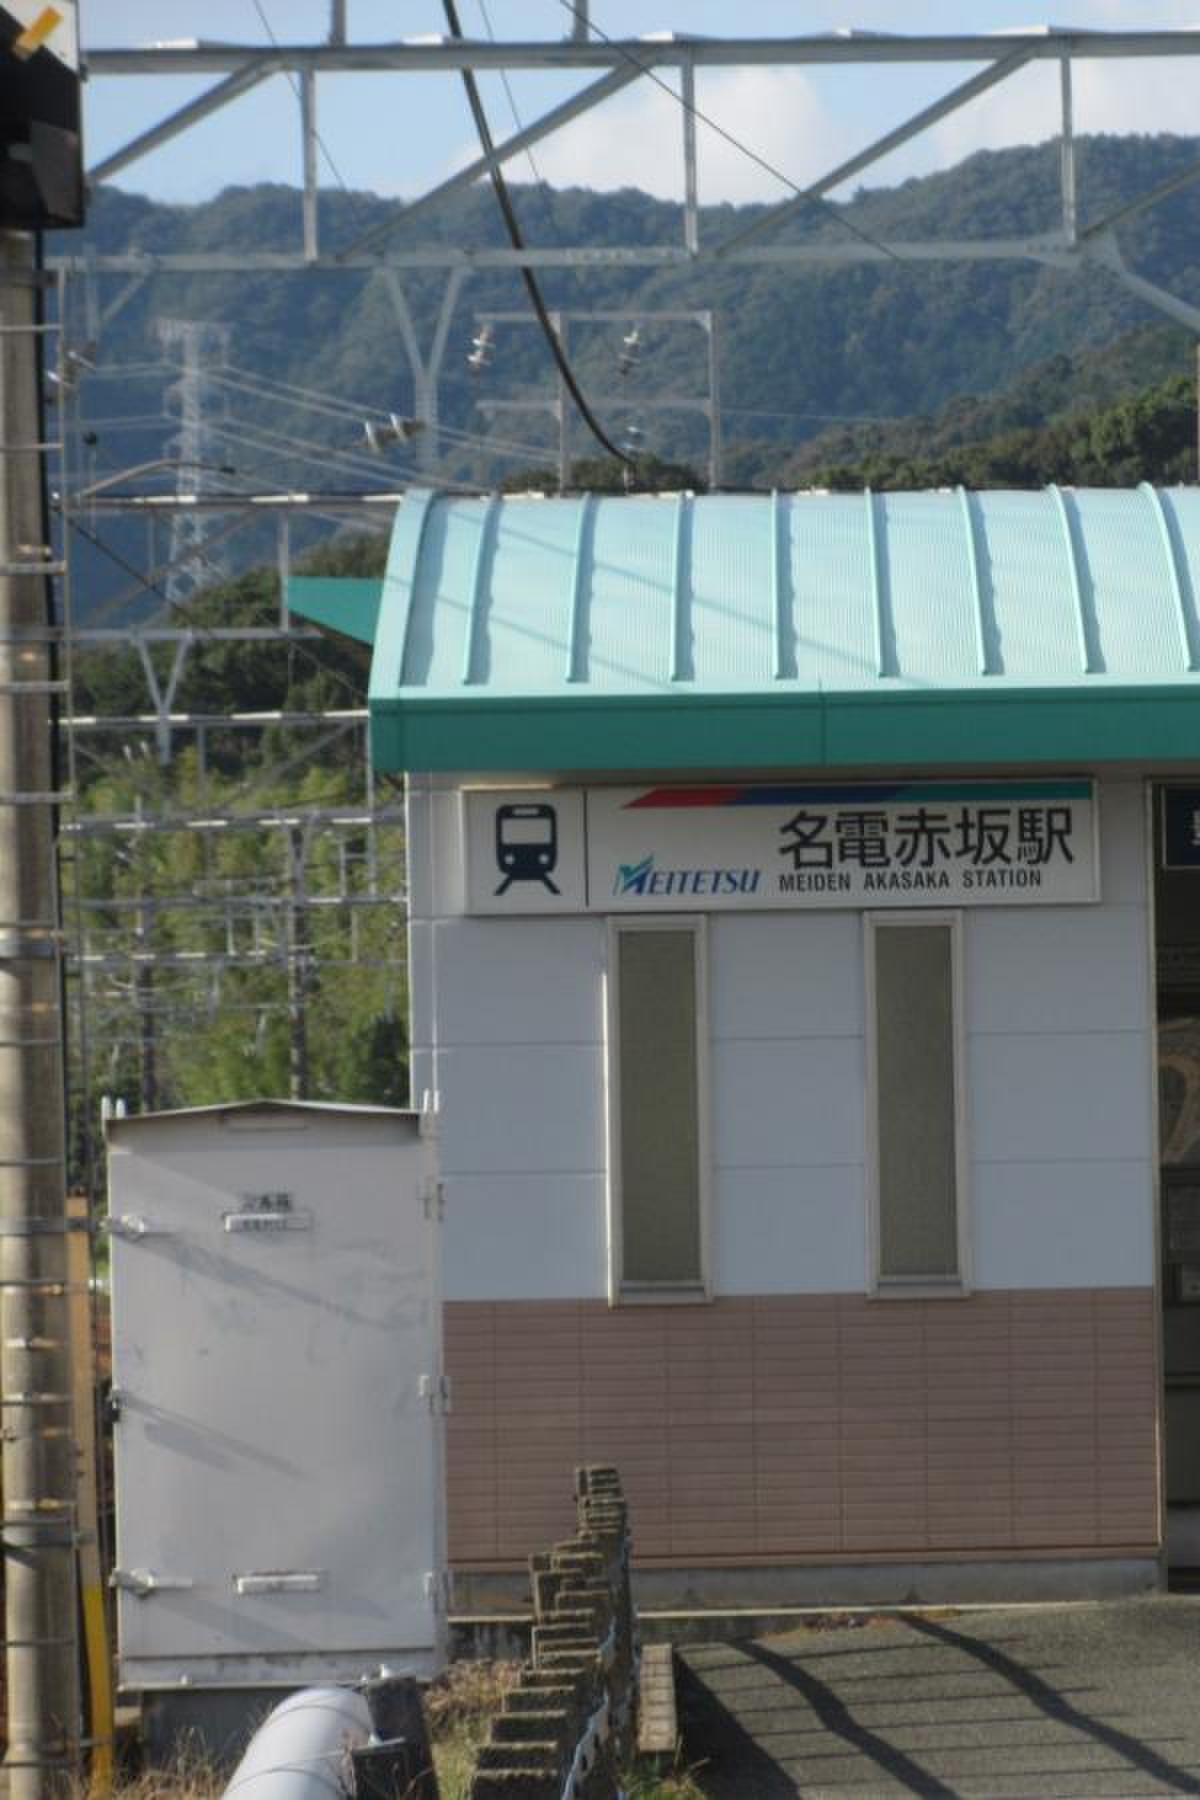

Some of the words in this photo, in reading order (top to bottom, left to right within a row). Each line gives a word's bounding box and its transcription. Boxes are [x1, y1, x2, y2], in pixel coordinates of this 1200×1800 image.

[779, 807, 1074, 869] 名電赤坂駅
[613, 853, 762, 896] MEITETSU
[779, 873, 851, 893] MEIDEN
[864, 871, 951, 890] AKASAKA
[962, 869, 1042, 888] STATION
